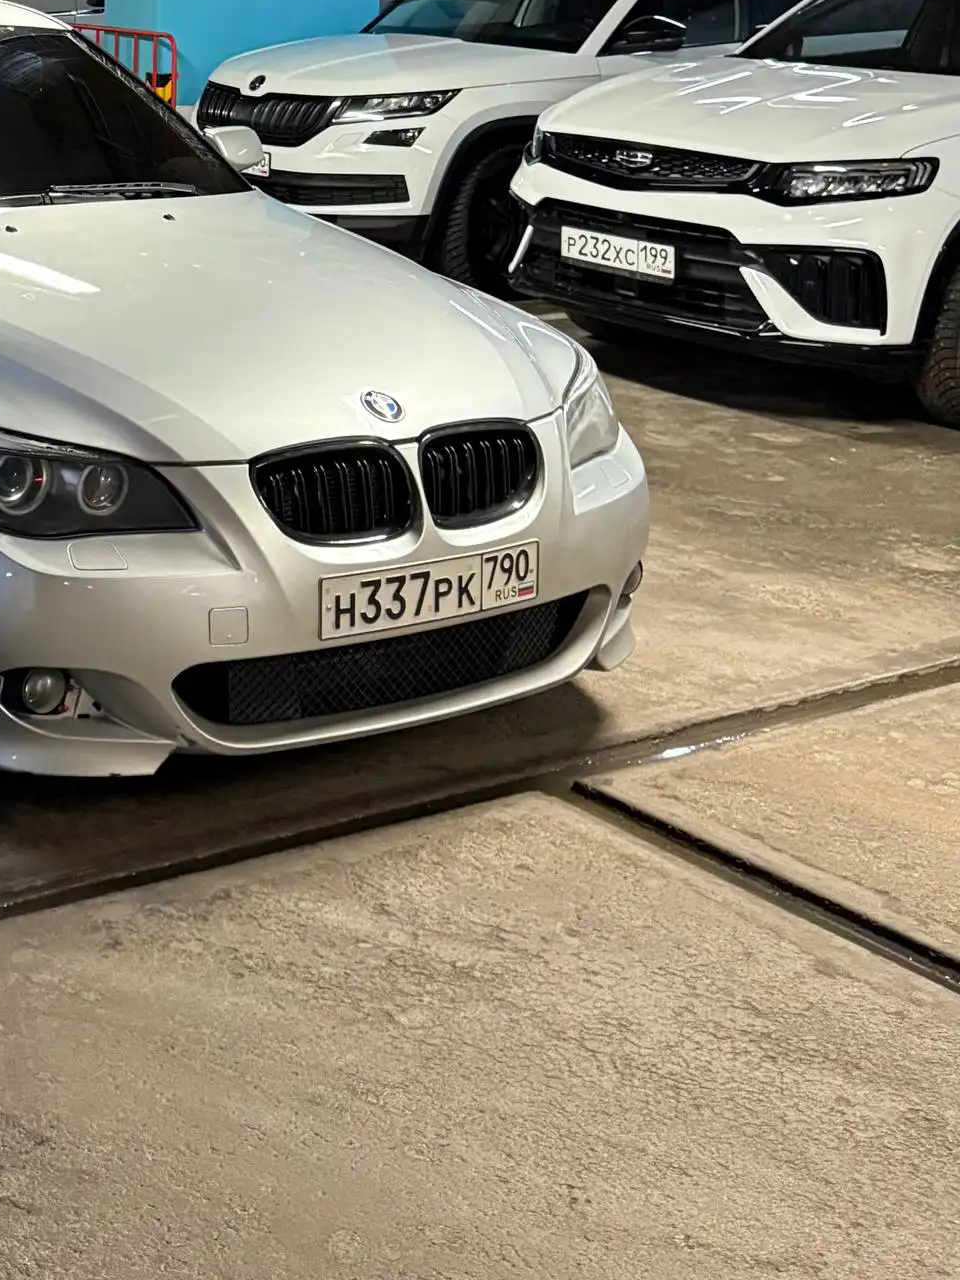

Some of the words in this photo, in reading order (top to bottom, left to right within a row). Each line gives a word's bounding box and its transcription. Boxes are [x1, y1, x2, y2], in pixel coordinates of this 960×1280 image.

[640, 244, 669, 266] 199
[484, 549, 530, 591] 790
[495, 585, 518, 603] RUS
